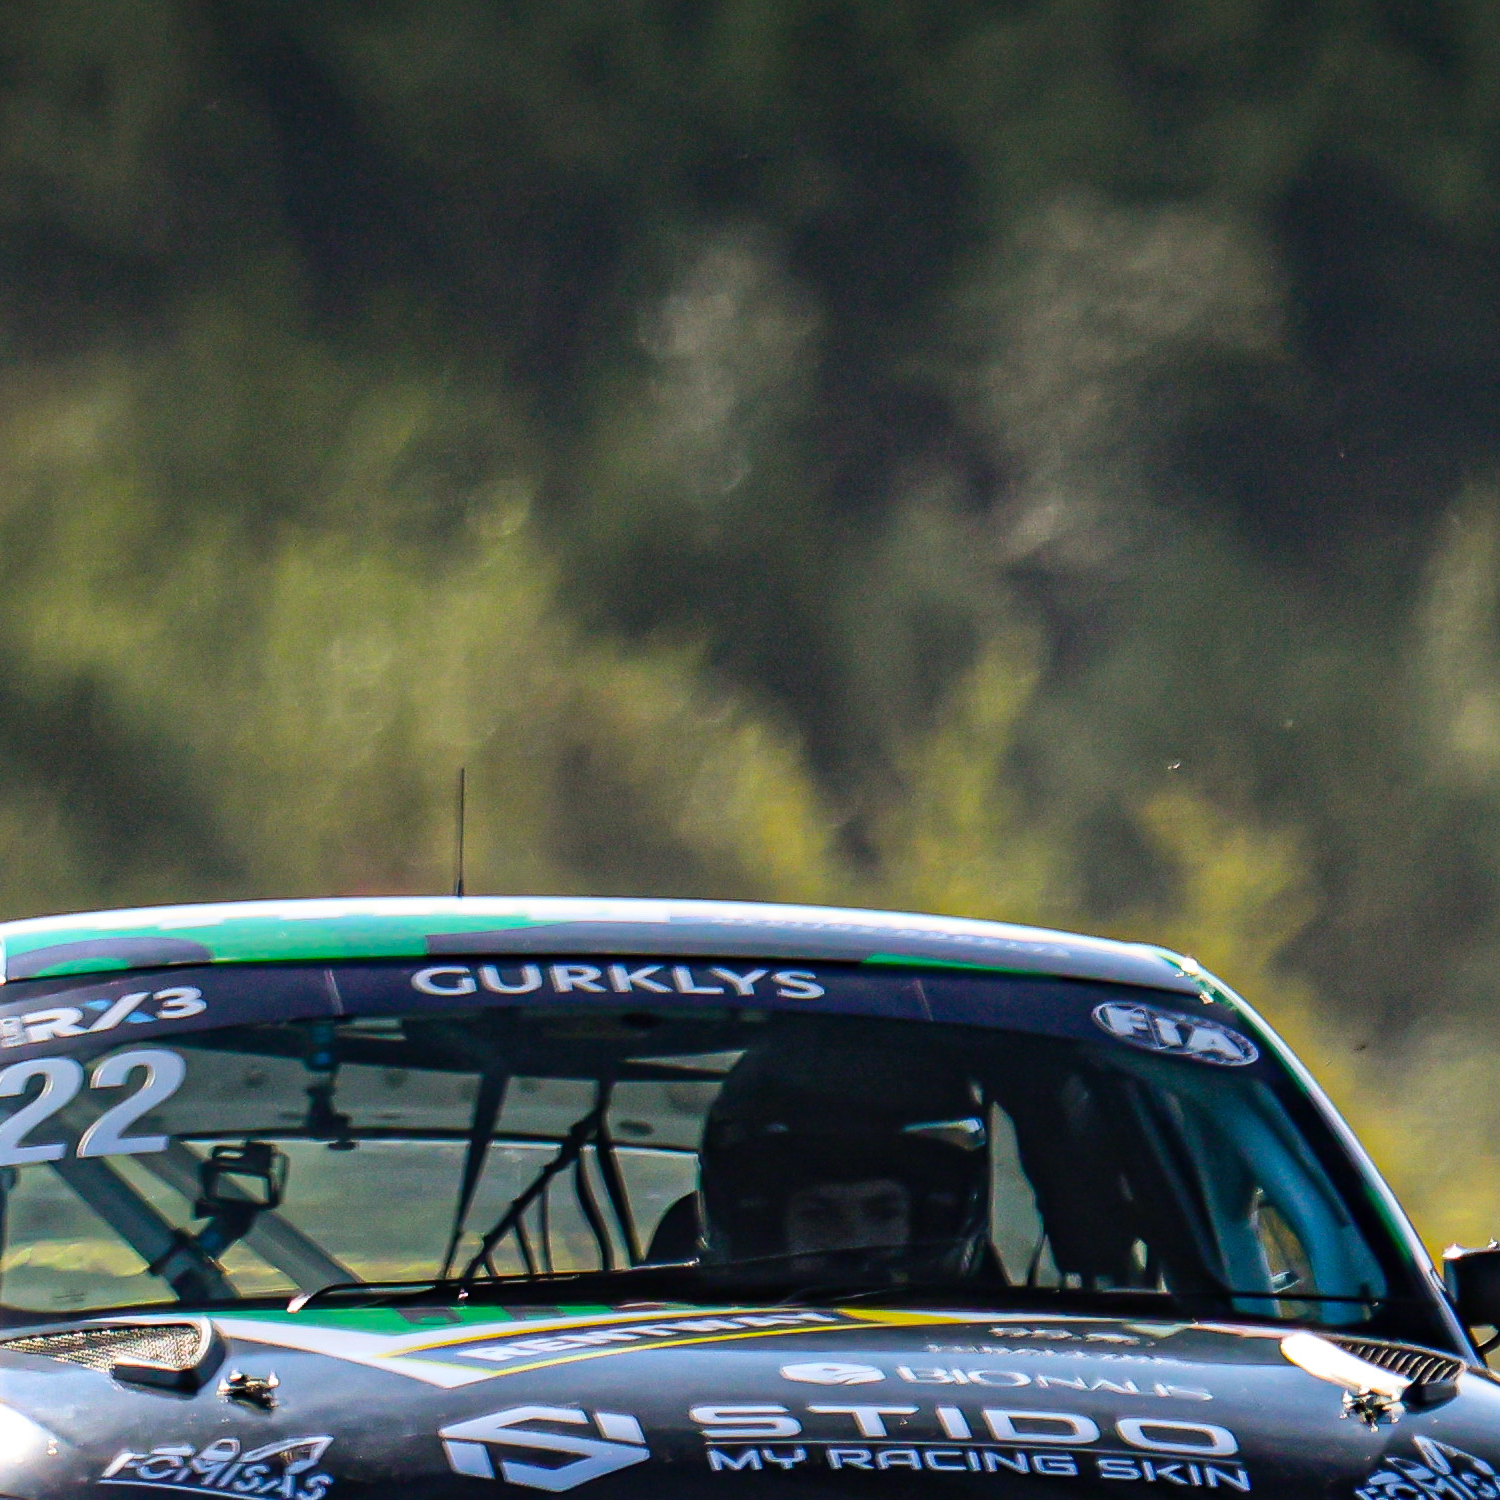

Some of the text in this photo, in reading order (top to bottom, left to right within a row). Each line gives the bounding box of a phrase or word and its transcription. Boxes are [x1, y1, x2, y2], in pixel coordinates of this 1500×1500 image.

[410, 964, 826, 1000] GURKLYS
[1102, 1003, 1246, 1062] FIA
[688, 1404, 1240, 1457] STIDO
[706, 1448, 1252, 1492] MY RACING SKIN
